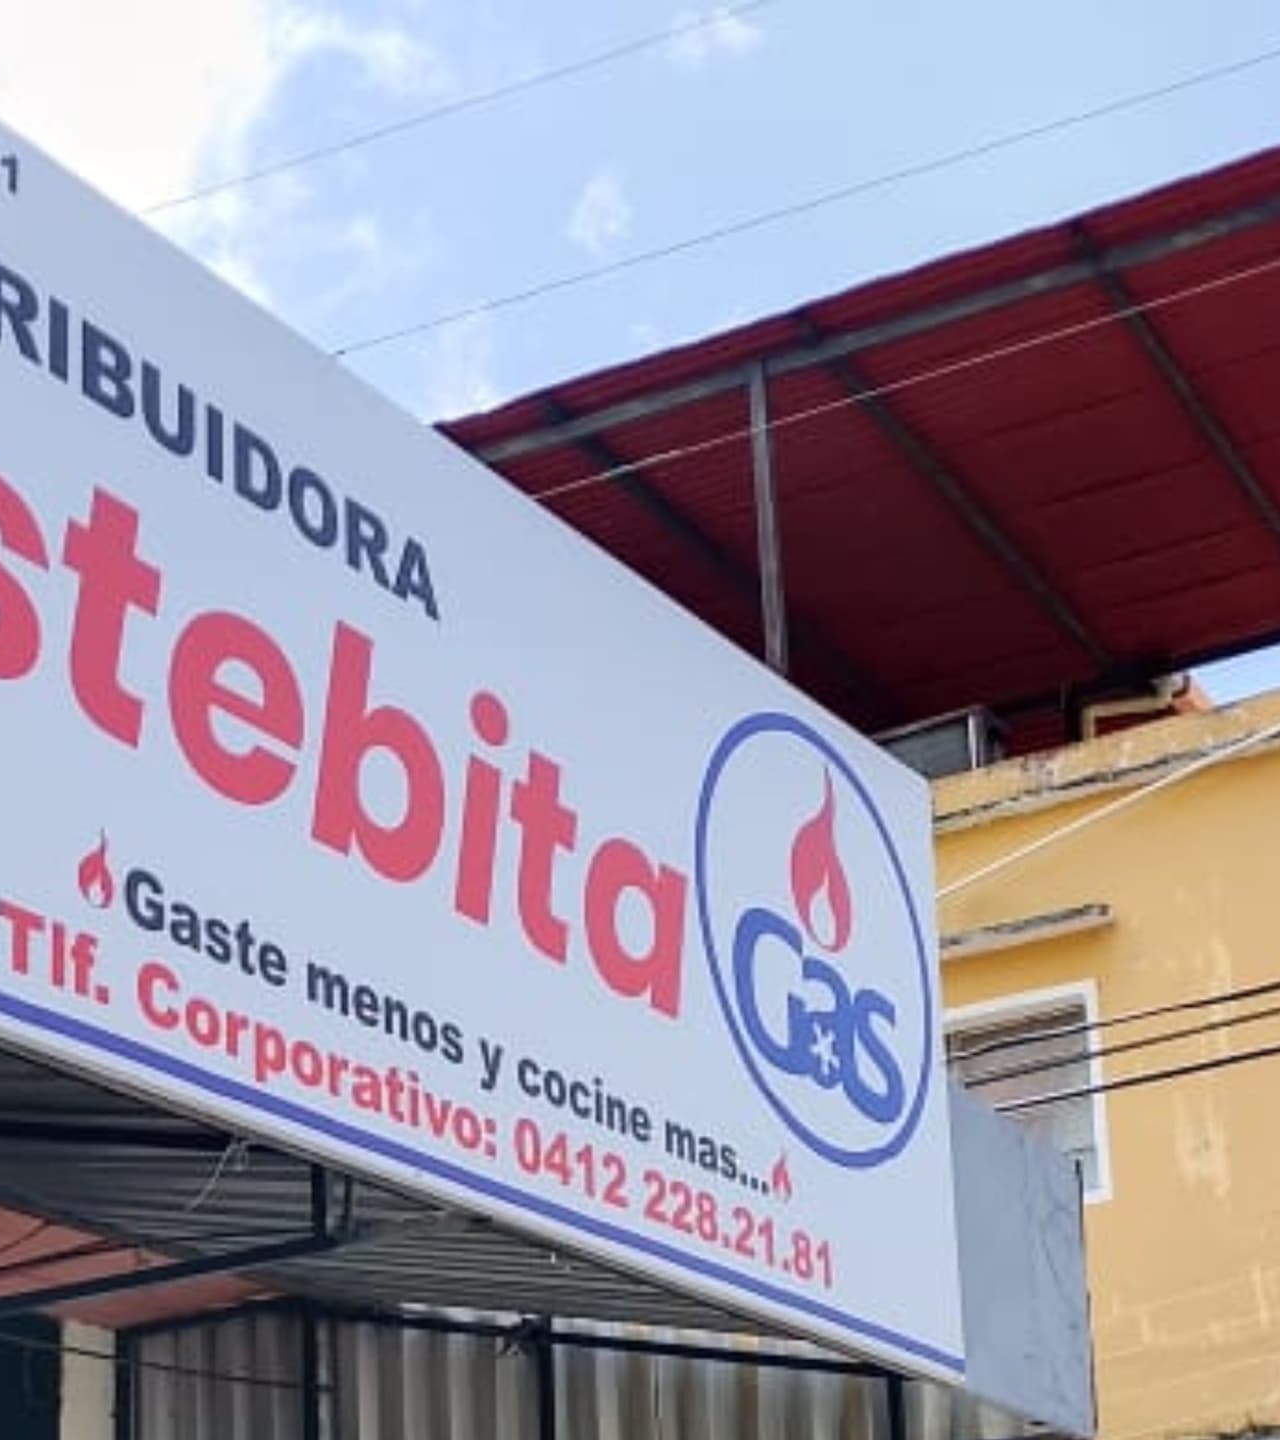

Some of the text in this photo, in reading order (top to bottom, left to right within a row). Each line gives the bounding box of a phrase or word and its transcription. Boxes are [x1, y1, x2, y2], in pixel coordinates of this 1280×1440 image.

[123, 867, 288, 987] Gaste
[305, 961, 465, 1064] menos
[478, 1037, 504, 1091] y
[516, 1057, 653, 1142] cocine
[135, 960, 498, 1158] Corporativo:
[513, 1120, 629, 1209] 0412
[642, 1169, 833, 1289] 228.21.81
